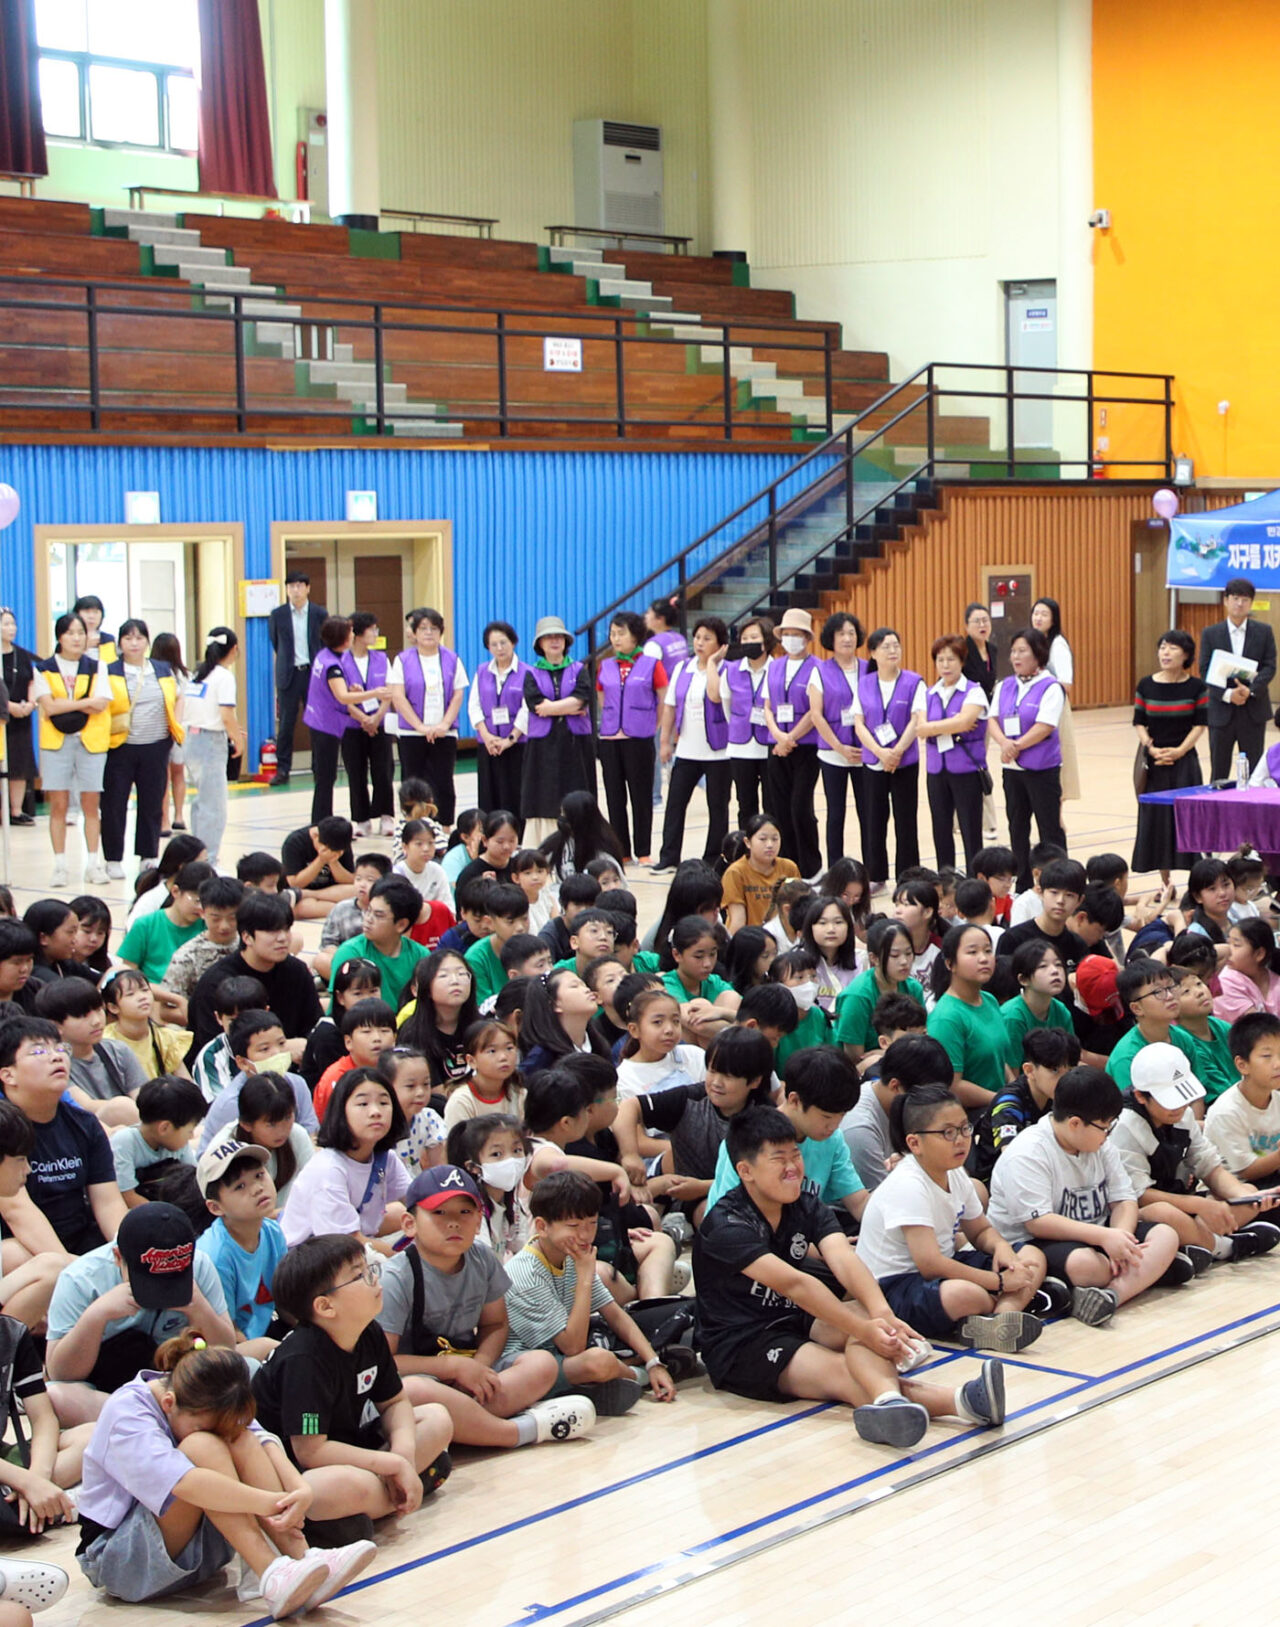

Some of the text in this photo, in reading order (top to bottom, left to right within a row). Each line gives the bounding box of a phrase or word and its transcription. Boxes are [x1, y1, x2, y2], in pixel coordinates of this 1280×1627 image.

[1227, 543, 1261, 571] 지구를
[439, 1169, 465, 1188] A
[1058, 1179, 1109, 1221] GREAT
